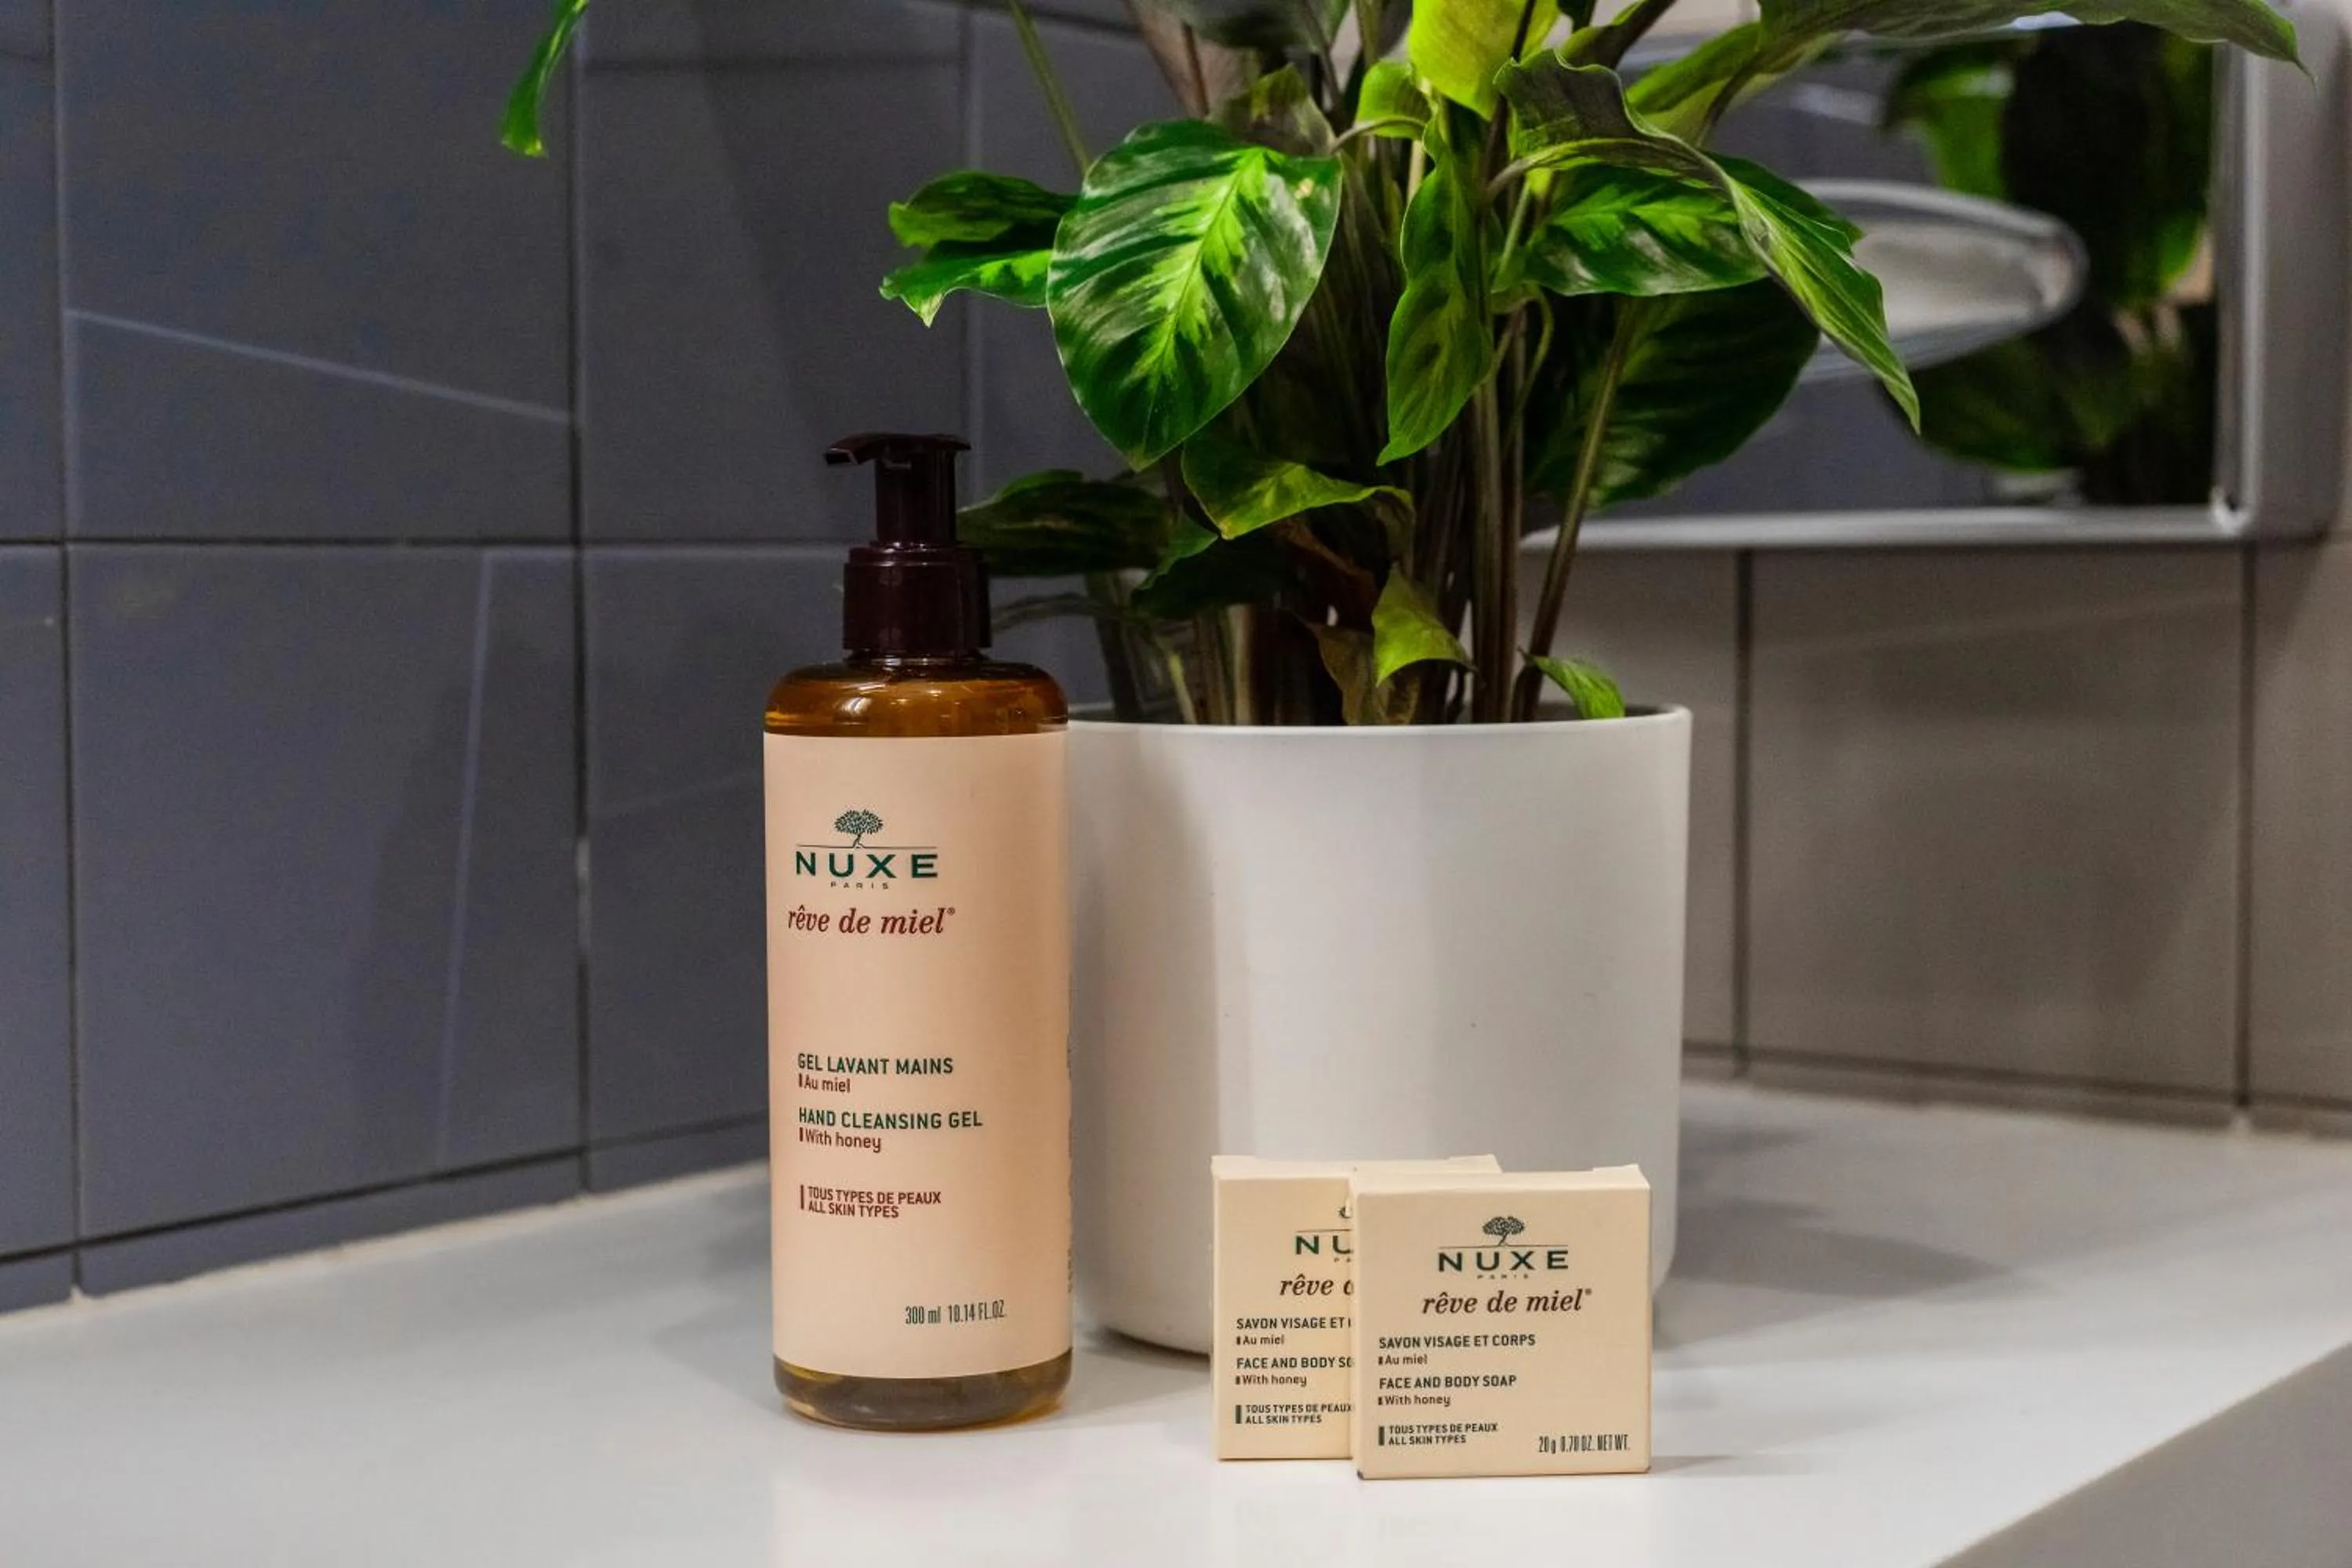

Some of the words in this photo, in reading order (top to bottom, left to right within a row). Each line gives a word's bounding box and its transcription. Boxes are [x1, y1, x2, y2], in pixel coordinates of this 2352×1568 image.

[796, 851, 938, 878] NUXE
[788, 905, 830, 931] rêve
[839, 908, 870, 933] de
[798, 1054, 822, 1071] GEL
[827, 1056, 889, 1074] LAVANT
[896, 1058, 953, 1075] MAINS
[804, 1076, 818, 1090] Au
[822, 1078, 850, 1093] miel
[799, 1108, 835, 1126] HAND
[842, 1112, 941, 1129] CLEANSING
[949, 1112, 982, 1127] GEL
[806, 1130, 831, 1145] With
[836, 1132, 881, 1152] honey
[808, 1186, 833, 1200] TOUS
[836, 1189, 873, 1203] TYPES
[877, 1191, 895, 1204] DE
[898, 1192, 941, 1204] PEAUX
[809, 1202, 825, 1214] ALL
[829, 1203, 855, 1216] SKIN
[858, 1205, 898, 1218] TYPES
[1439, 1250, 1568, 1272] NUXE
[1280, 1274, 1333, 1295] rêve
[1423, 1292, 1477, 1315] rêve
[1487, 1290, 1517, 1312] de
[906, 1307, 924, 1323] 300
[927, 1306, 941, 1323] ml
[949, 1305, 975, 1323] 10.14
[1237, 1319, 1277, 1329] SAVON
[1281, 1318, 1326, 1328] VISAGE
[1330, 1318, 1345, 1328] ET
[1243, 1336, 1256, 1345] Au
[1260, 1335, 1284, 1345] miel
[1380, 1337, 1420, 1348] SAVON
[1423, 1336, 1470, 1348] VISAGE
[1474, 1336, 1490, 1346] ET
[1493, 1334, 1535, 1346] CORPS
[1237, 1358, 1267, 1368] FACE
[1271, 1358, 1297, 1368] AND
[1301, 1358, 1335, 1368] BODY
[1385, 1355, 1399, 1365] Au
[1403, 1354, 1427, 1365] miel
[1242, 1375, 1268, 1385] With
[1272, 1374, 1306, 1388] honey
[1380, 1377, 1410, 1389] FACE
[1414, 1377, 1440, 1388] AND
[1445, 1376, 1479, 1388] BODY
[1483, 1375, 1517, 1386] SOAP
[1273, 1404, 1304, 1413] TYPES
[1385, 1396, 1410, 1405] With
[1414, 1396, 1450, 1406] honey
[1246, 1415, 1263, 1424] ALL
[1266, 1415, 1289, 1424] SKIN
[1291, 1415, 1322, 1424] TYPES
[1389, 1425, 1414, 1434] TOUS
[1416, 1425, 1447, 1433] TYPES
[1389, 1436, 1406, 1445] ALL
[1409, 1436, 1434, 1444] SKIN
[1436, 1435, 1466, 1443] TYPES
